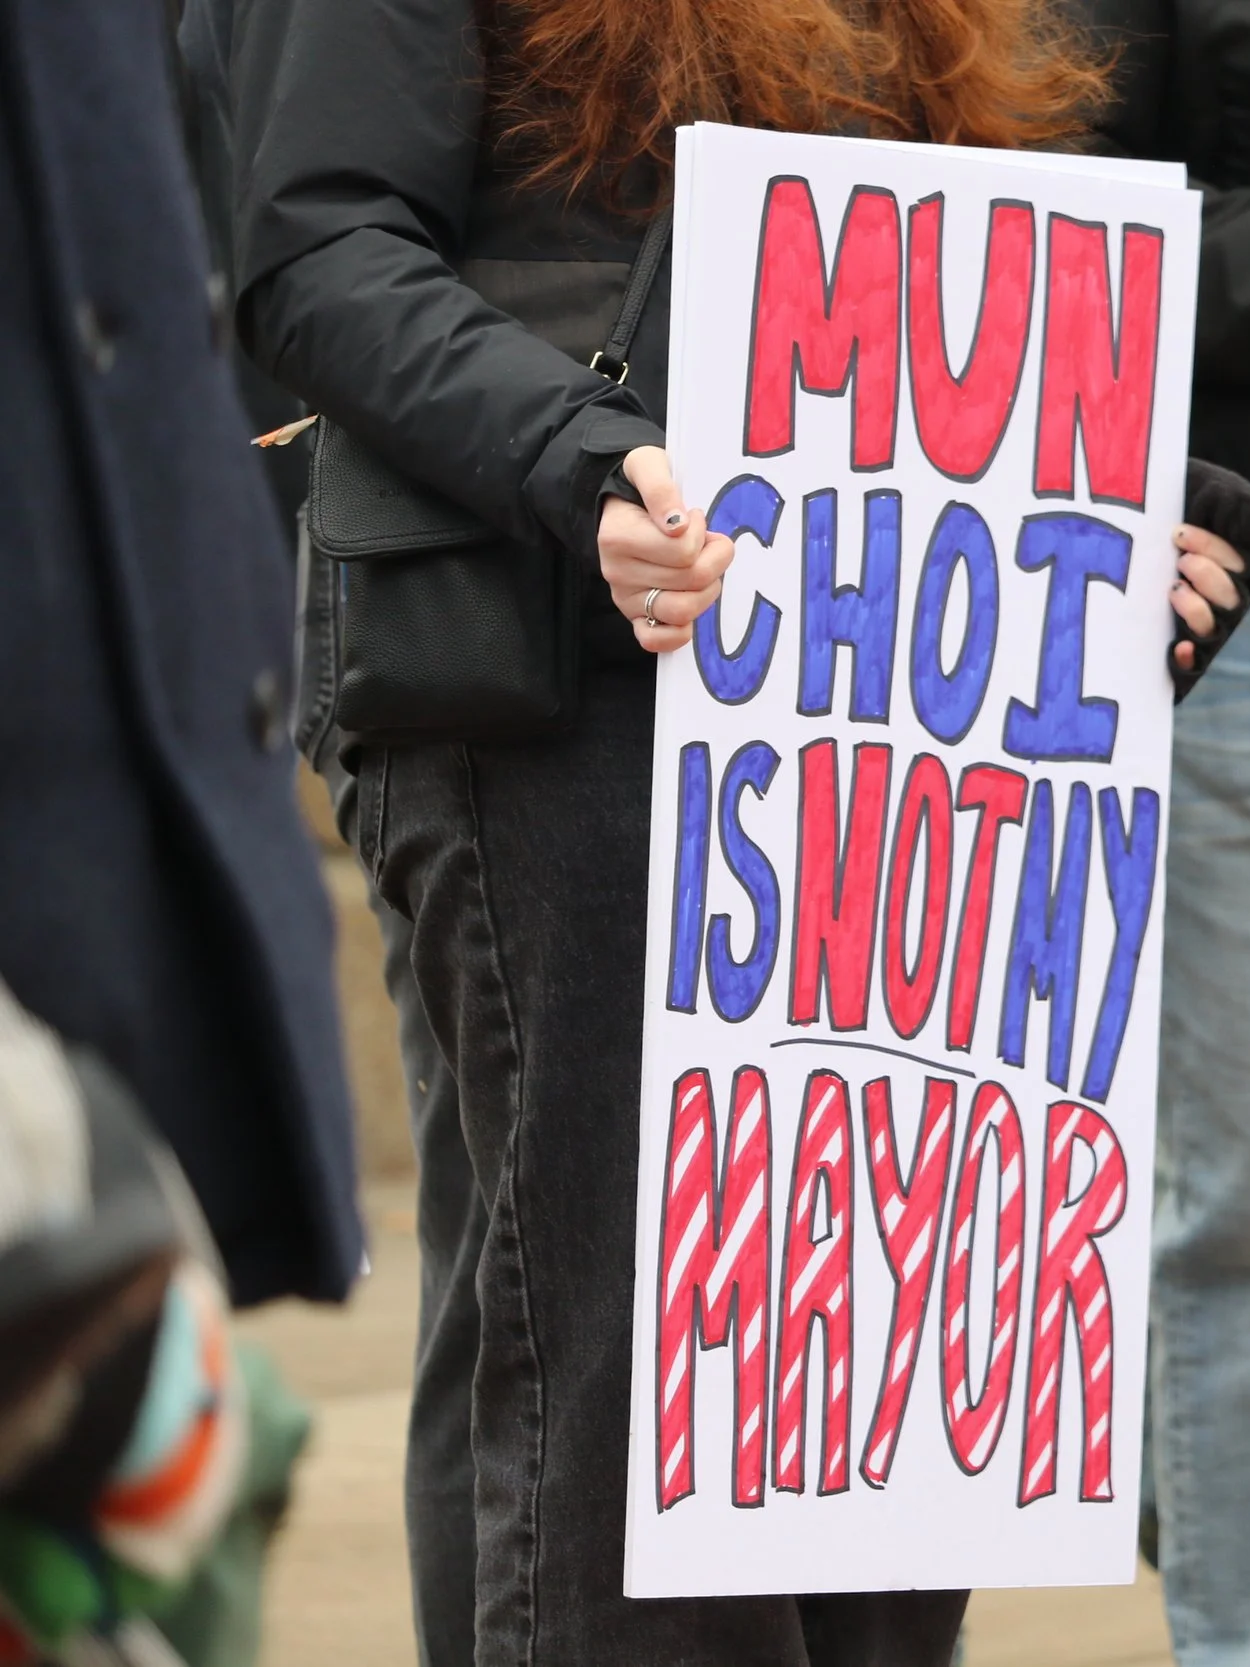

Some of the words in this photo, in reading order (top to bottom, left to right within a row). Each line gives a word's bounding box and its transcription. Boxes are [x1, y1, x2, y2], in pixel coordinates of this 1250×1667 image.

[742, 174, 1163, 513] MUN
[692, 473, 1133, 763] CHOI
[666, 740, 781, 1022] IS
[788, 740, 1028, 1052] NOT
[998, 778, 1160, 1104] MY
[656, 1066, 1127, 1513] MAYOR
